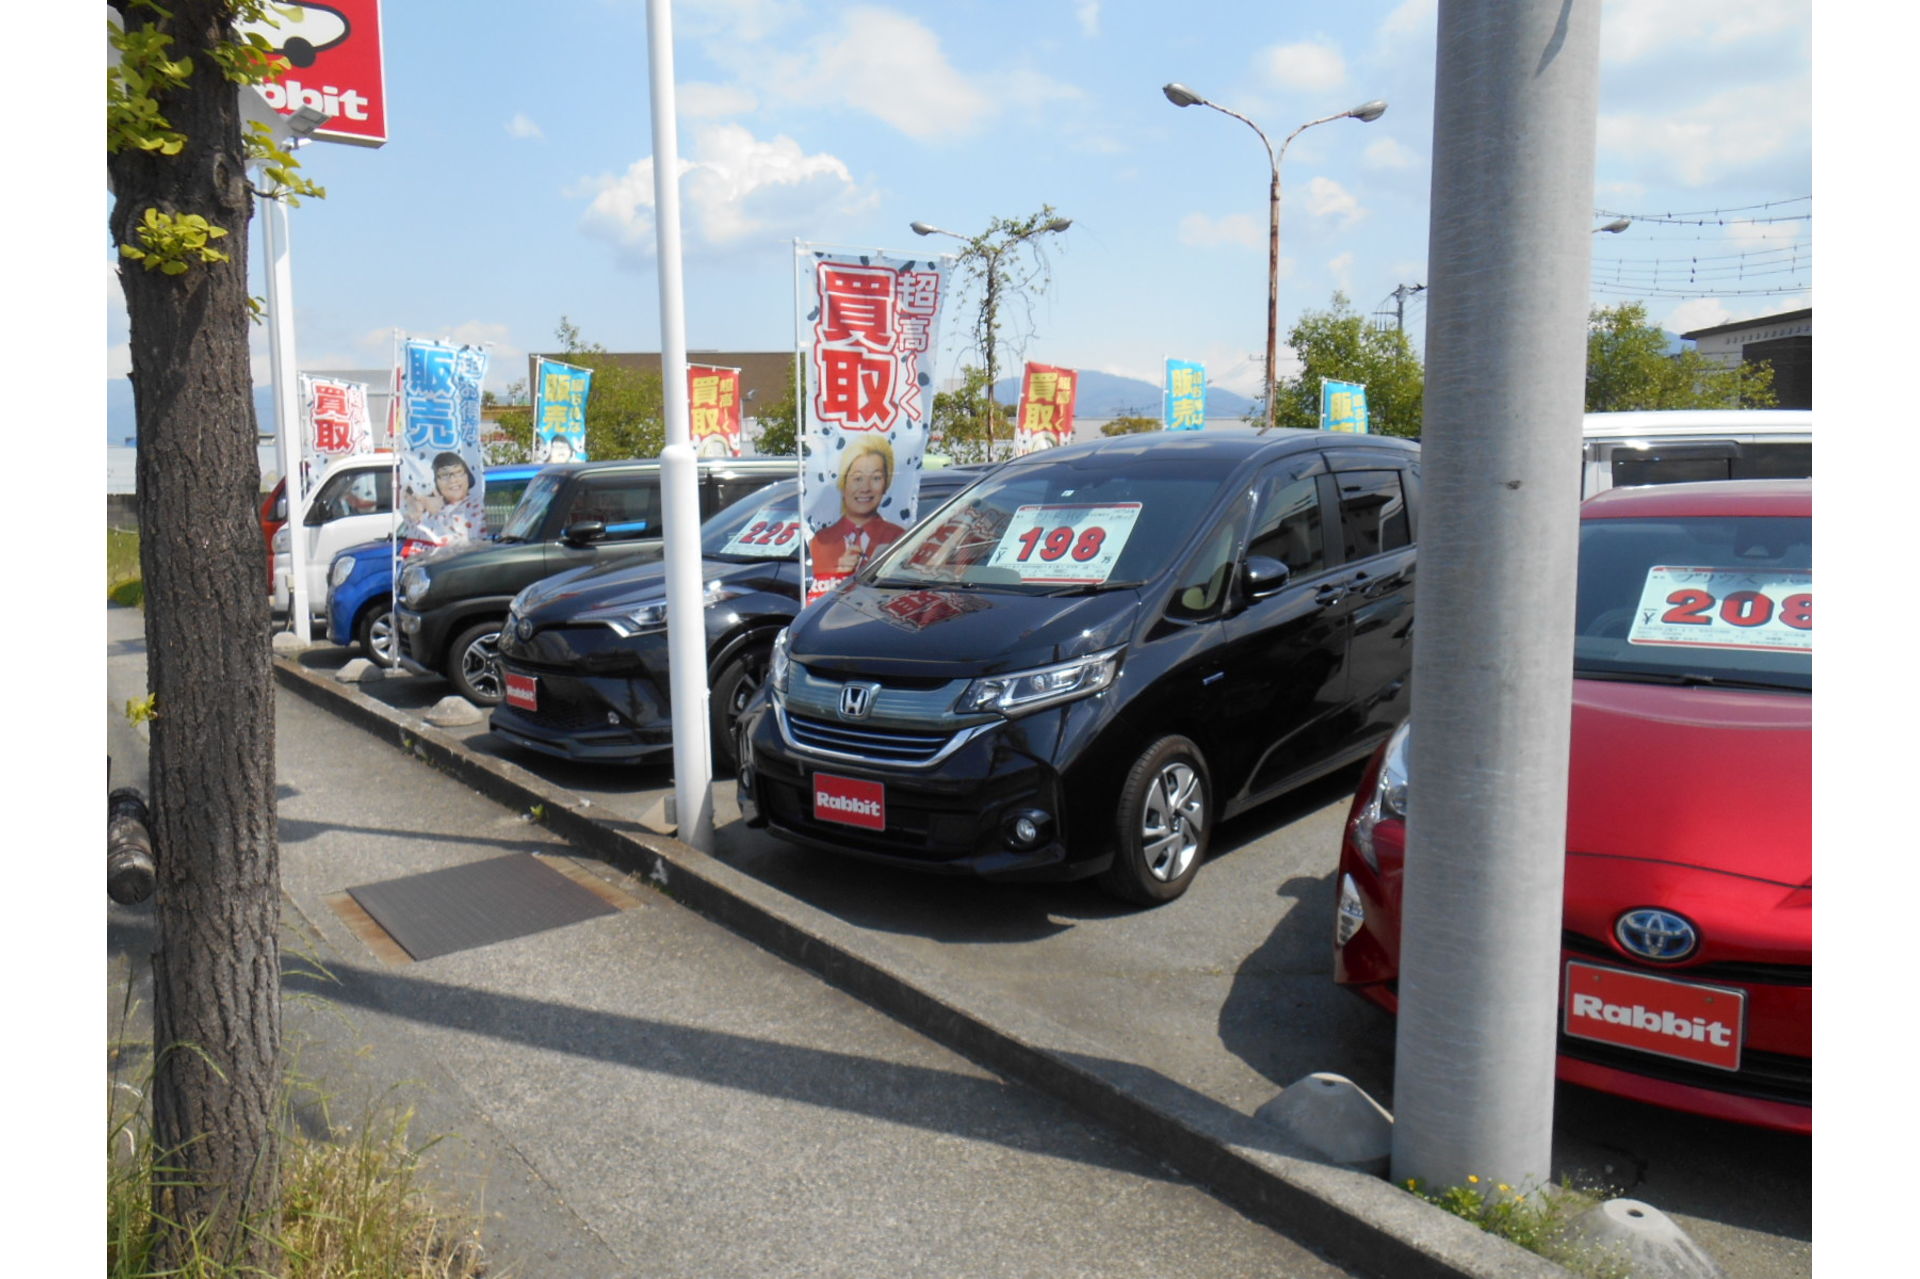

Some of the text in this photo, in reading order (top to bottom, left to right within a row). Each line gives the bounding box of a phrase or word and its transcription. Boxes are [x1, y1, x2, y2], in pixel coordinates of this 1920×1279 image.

[816, 263, 897, 431] 買取
[311, 385, 354, 453] 買取
[405, 343, 456, 449] 販売
[544, 373, 571, 432] 販売
[692, 377, 720, 436] 買取
[1024, 373, 1057, 431] 買取
[1172, 368, 1193, 427] 販売
[1017, 526, 1106, 561] 198
[1661, 589, 1812, 630] 208
[817, 791, 881, 816] Rabbit
[1573, 993, 1731, 1047] Rabbit
